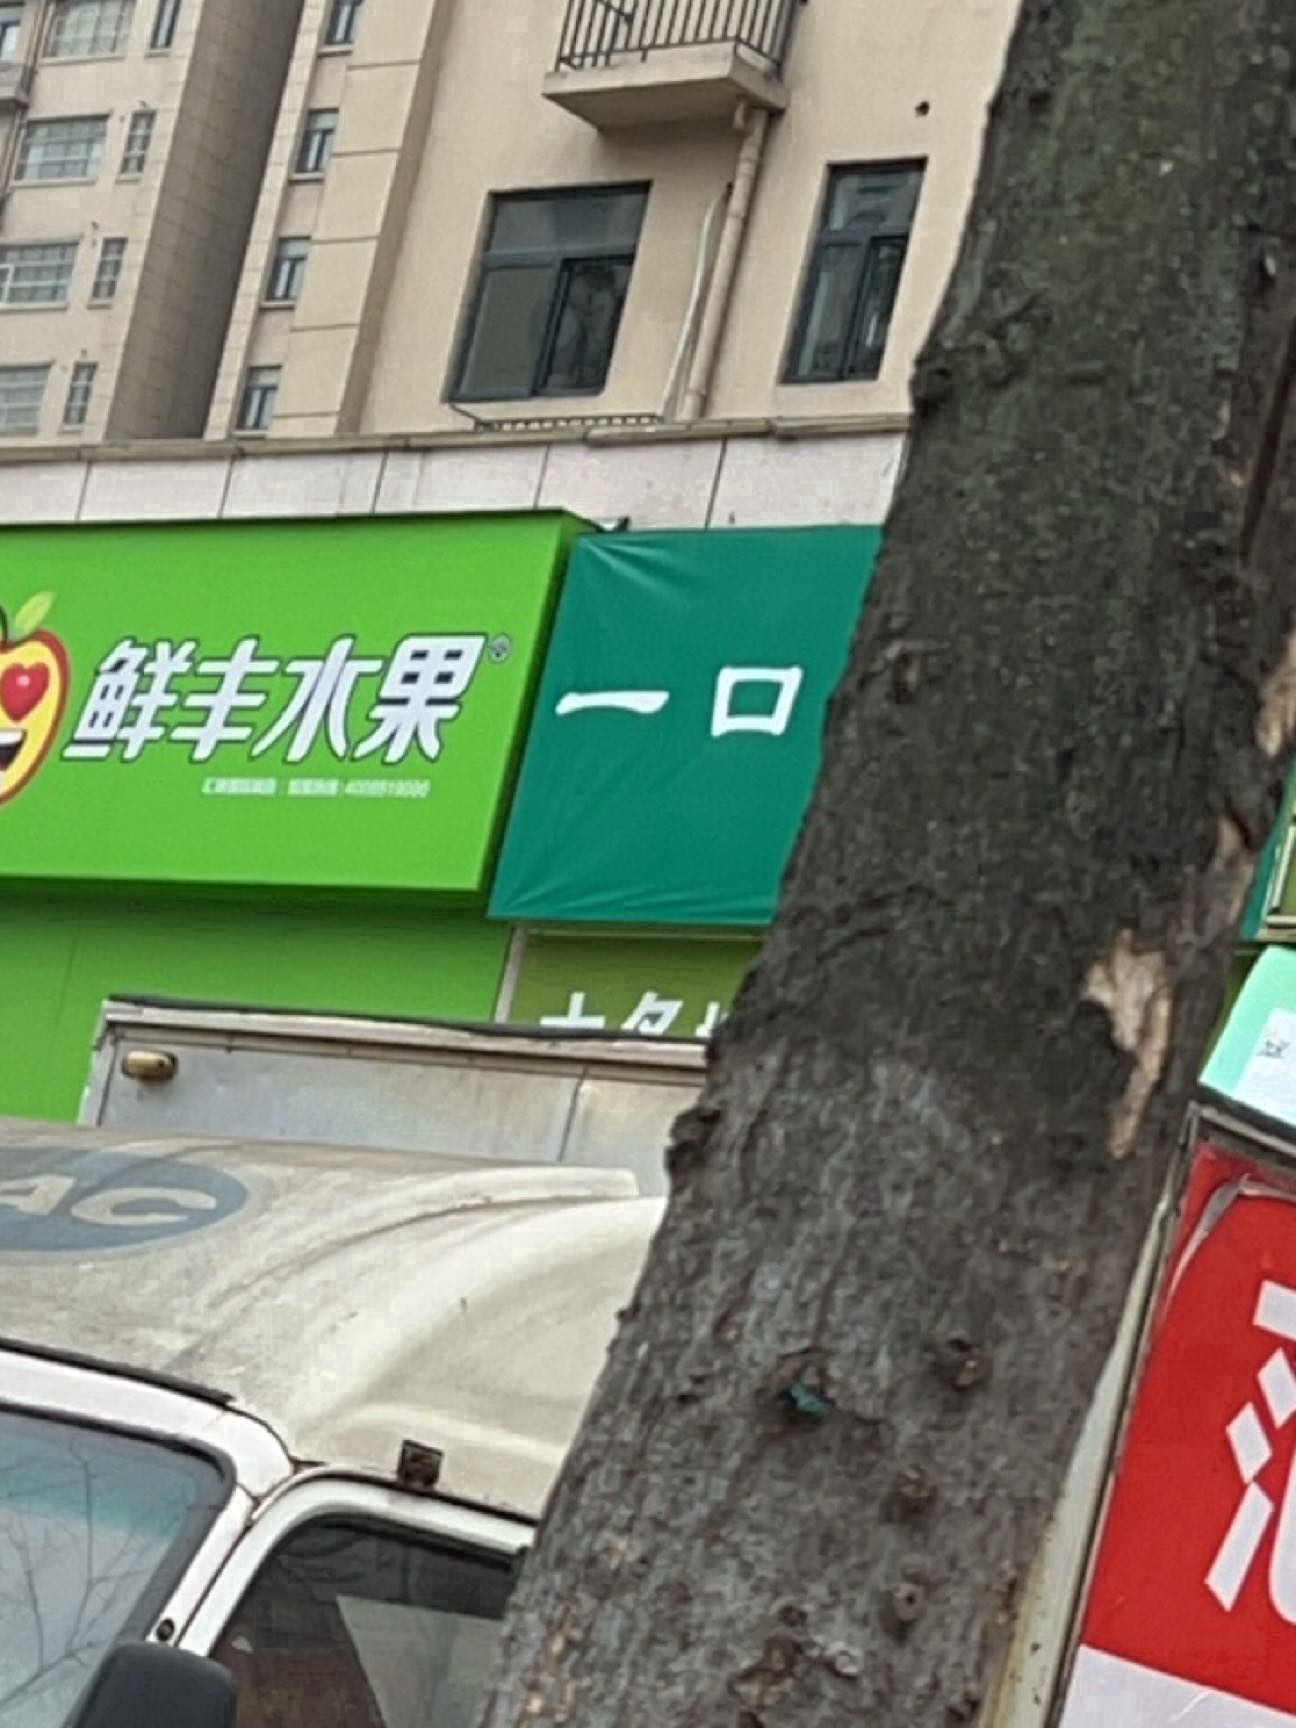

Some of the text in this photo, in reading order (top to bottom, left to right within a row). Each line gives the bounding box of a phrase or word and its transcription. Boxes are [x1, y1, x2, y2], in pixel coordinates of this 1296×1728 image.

[61, 633, 489, 764] 鲜丰水果
[555, 664, 802, 738] 一口
